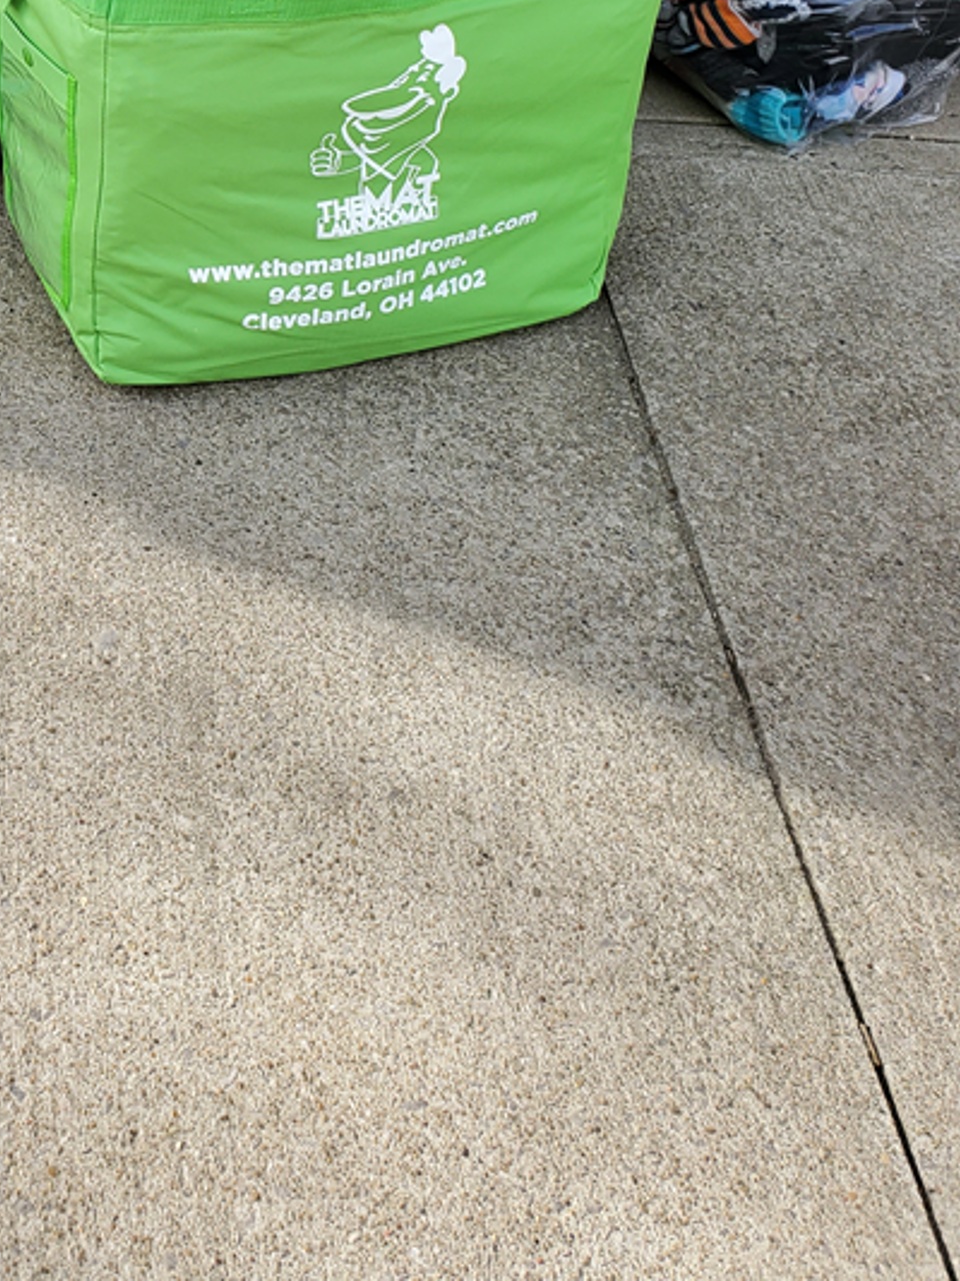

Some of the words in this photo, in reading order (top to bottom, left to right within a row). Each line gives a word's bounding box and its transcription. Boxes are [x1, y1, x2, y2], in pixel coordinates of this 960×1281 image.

[316, 193, 366, 223] THE
[362, 172, 441, 213] MAT
[316, 196, 439, 239] LAUNDROMAT
[188, 210, 538, 284] www.thematlaundromat.com
[242, 301, 372, 331] Cleveland,
[379, 290, 414, 313] OH
[420, 268, 487, 302] 44102
[269, 281, 334, 305] 9426
[341, 269, 415, 298] Lorain
[421, 256, 467, 279] Ave.
